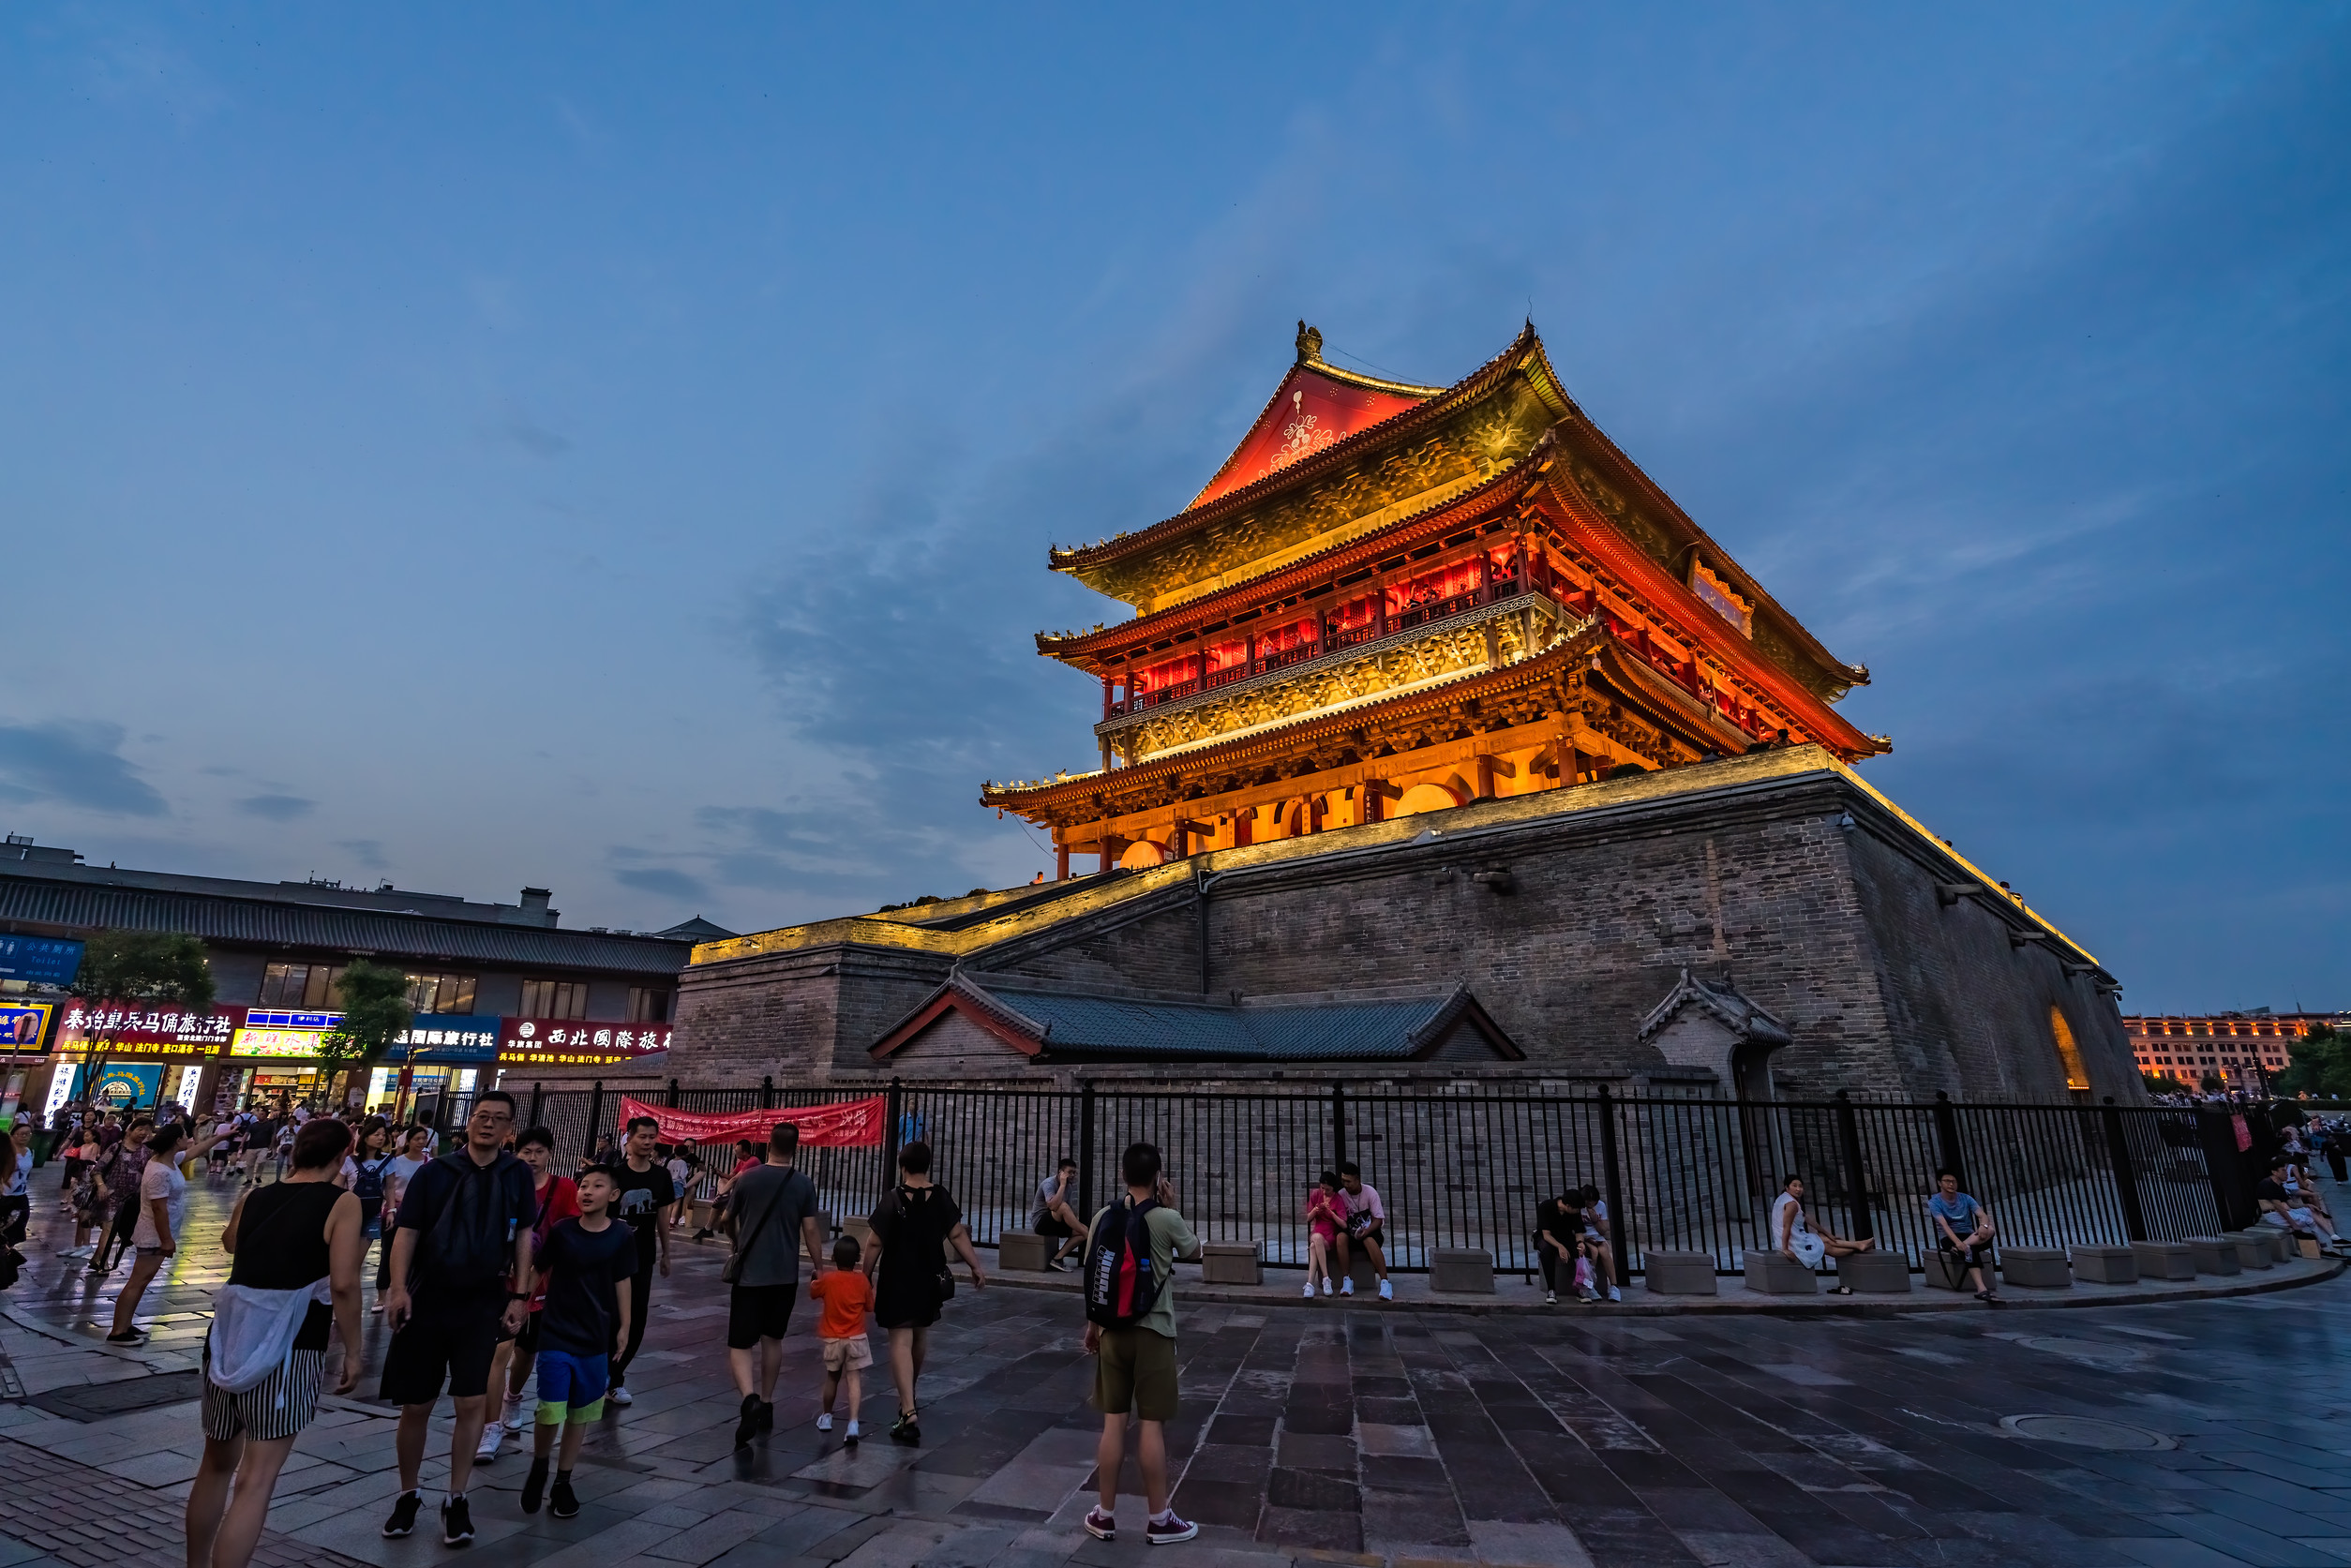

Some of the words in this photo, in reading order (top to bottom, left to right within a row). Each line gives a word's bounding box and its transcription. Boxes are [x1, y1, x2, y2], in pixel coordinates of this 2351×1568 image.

[25, 941, 76, 956] 公共厕所
[31, 956, 61, 965] Toilet
[64, 1008, 232, 1035] 秦始皇兵马俑旅行社
[114, 1042, 132, 1053] 华山
[135, 1042, 159, 1054] 法门寺
[196, 1045, 221, 1056] 一日游
[499, 1053, 525, 1062] 兵马俑
[529, 1053, 554, 1064] 华清池
[559, 1054, 575, 1064] 华山
[577, 1054, 601, 1064] 法门寺
